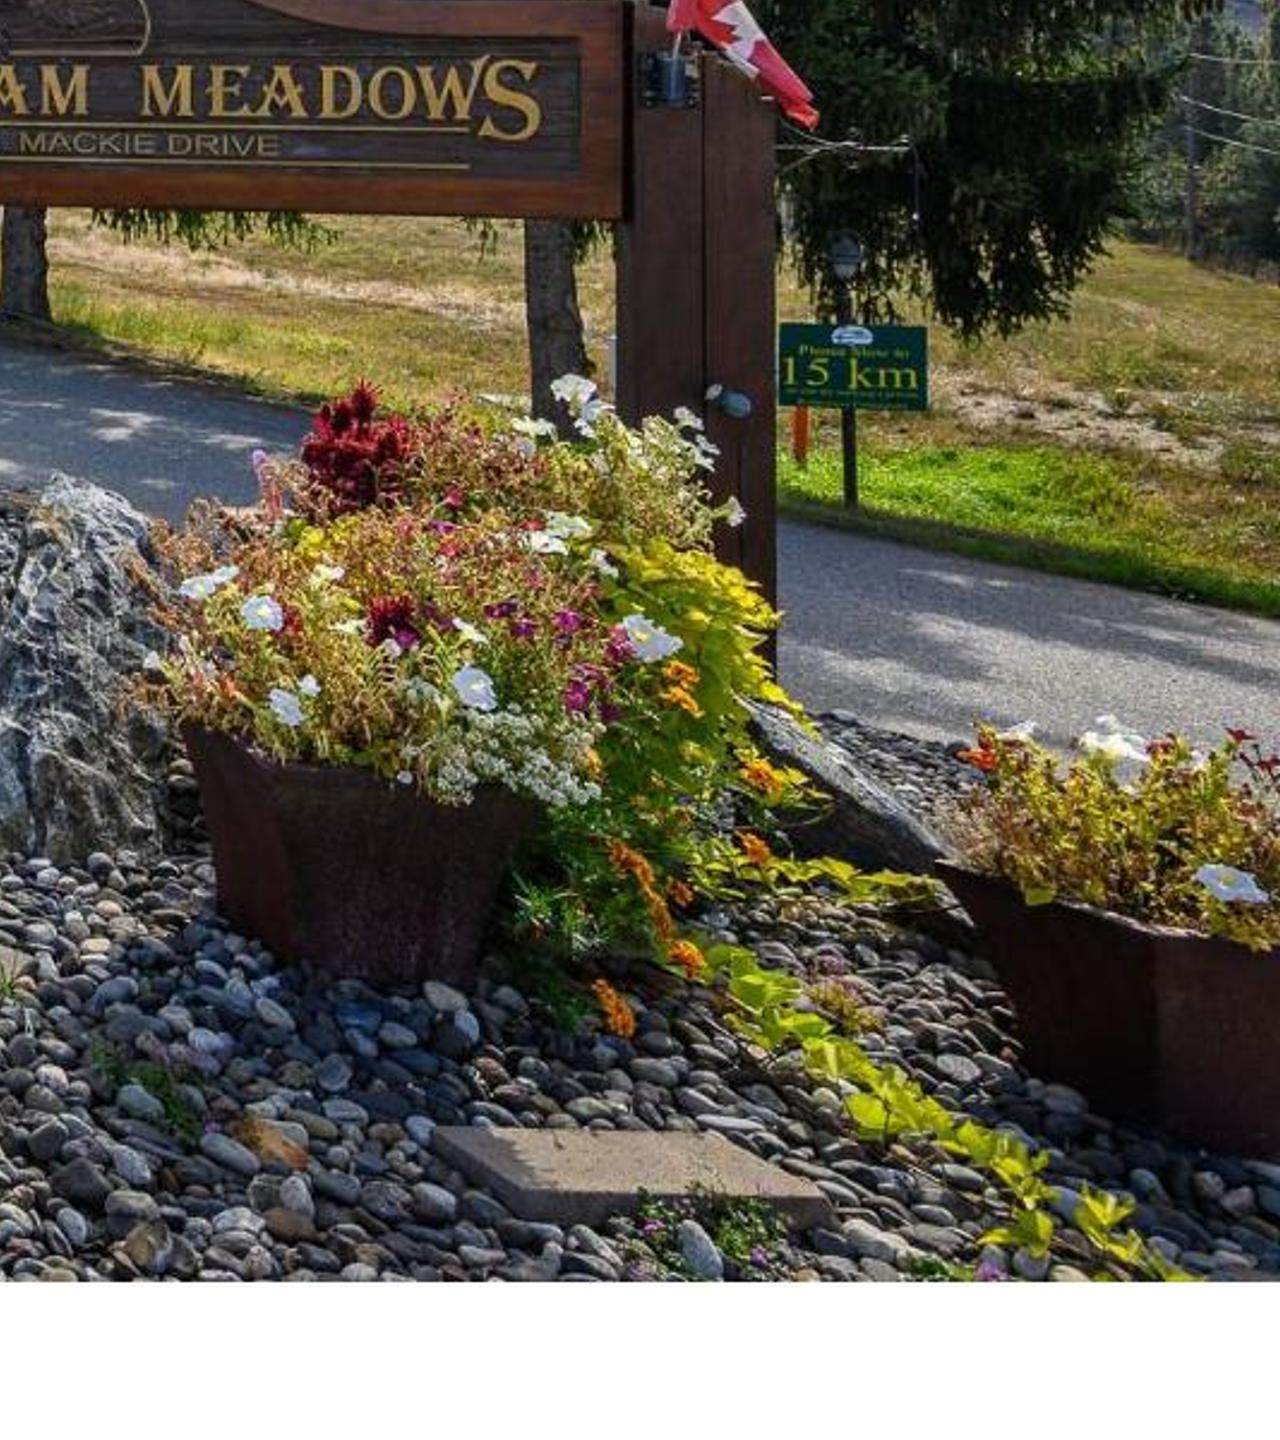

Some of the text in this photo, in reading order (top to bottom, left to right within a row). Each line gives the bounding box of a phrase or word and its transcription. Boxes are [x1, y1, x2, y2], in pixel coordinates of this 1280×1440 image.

[140, 54, 541, 141] MEADOWS
[20, 131, 156, 154] MACKIE
[168, 134, 279, 156] DRIVE
[783, 356, 917, 390] 15 km
